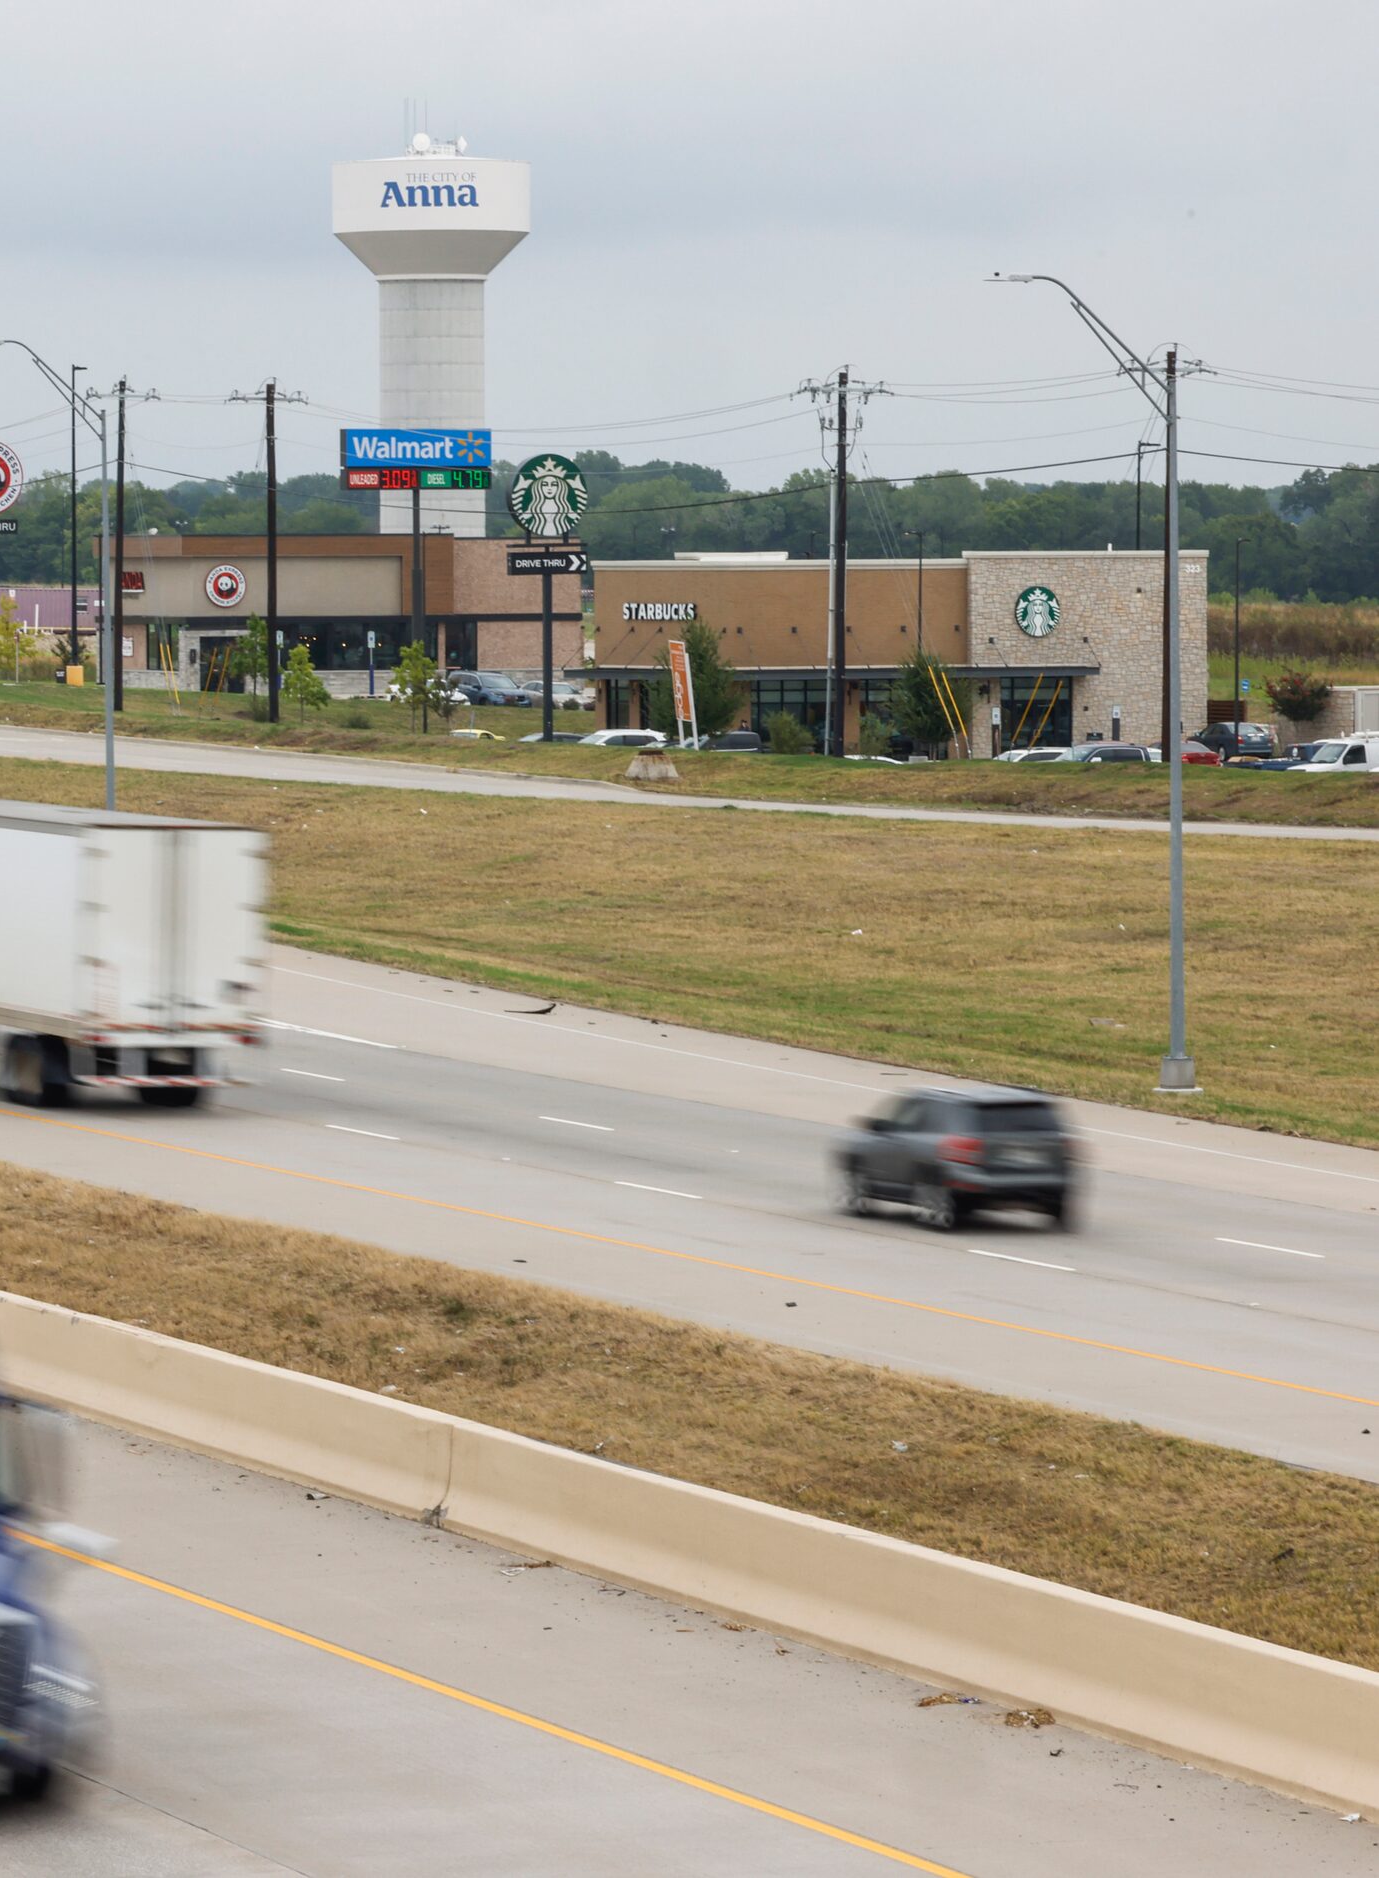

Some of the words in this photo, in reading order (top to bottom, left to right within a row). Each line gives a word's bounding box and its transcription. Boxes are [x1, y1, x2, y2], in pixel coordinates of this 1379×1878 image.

[406, 172, 428, 183] THE
[432, 172, 458, 183] CITY
[461, 172, 477, 183] OF
[380, 181, 479, 208] Anna
[352, 436, 454, 459] Walmart
[349, 473, 379, 485] UNLEADED
[427, 473, 446, 485] DIESEL
[515, 559, 541, 568] DRIVE
[543, 558, 566, 567] THRU
[623, 602, 695, 620] STARBUCKS
